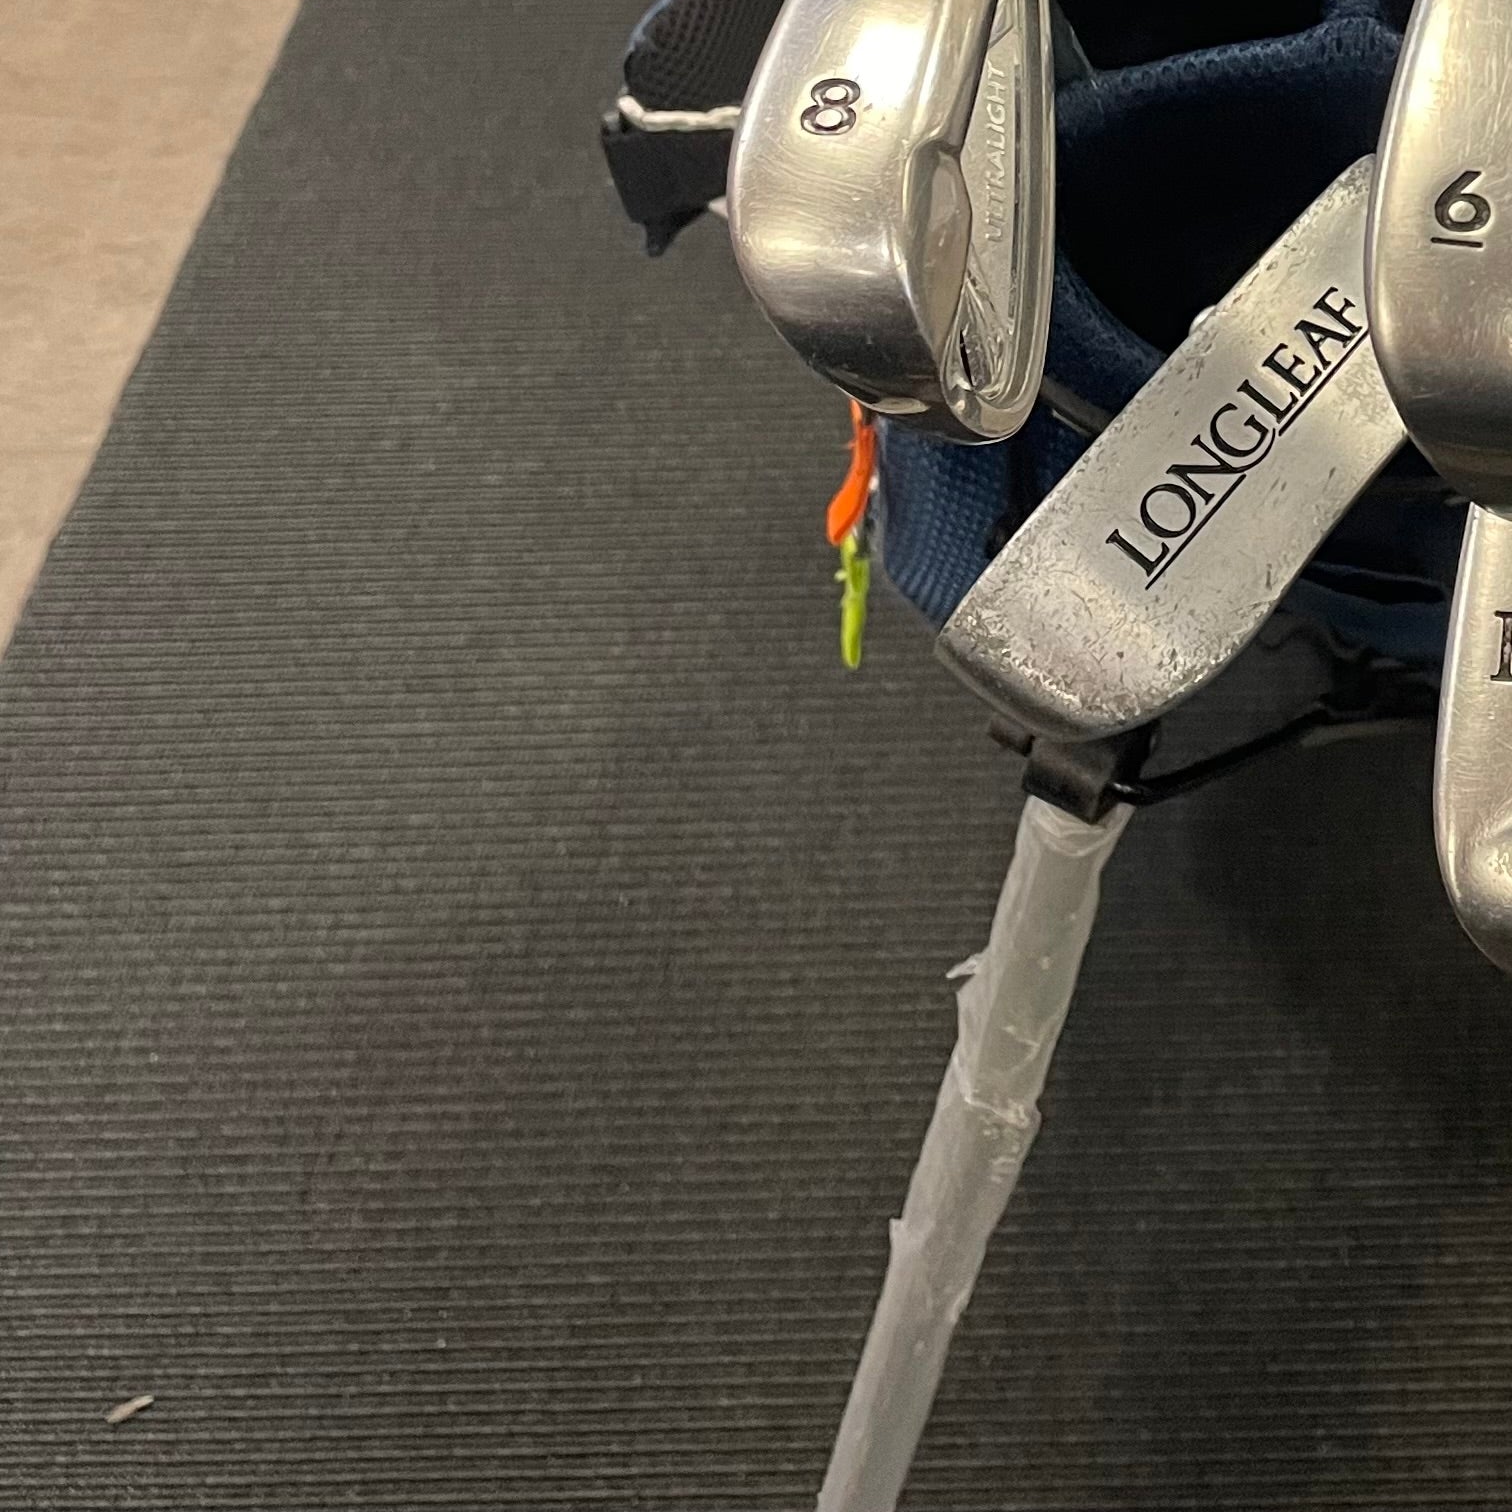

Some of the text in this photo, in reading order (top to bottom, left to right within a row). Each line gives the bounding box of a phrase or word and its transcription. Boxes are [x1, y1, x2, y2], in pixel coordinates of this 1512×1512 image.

[800, 77, 861, 135] 8
[986, 59, 1006, 243] ULTRALIGHT
[1433, 169, 1492, 233] 6
[1104, 286, 1366, 590] LONGLEAF
